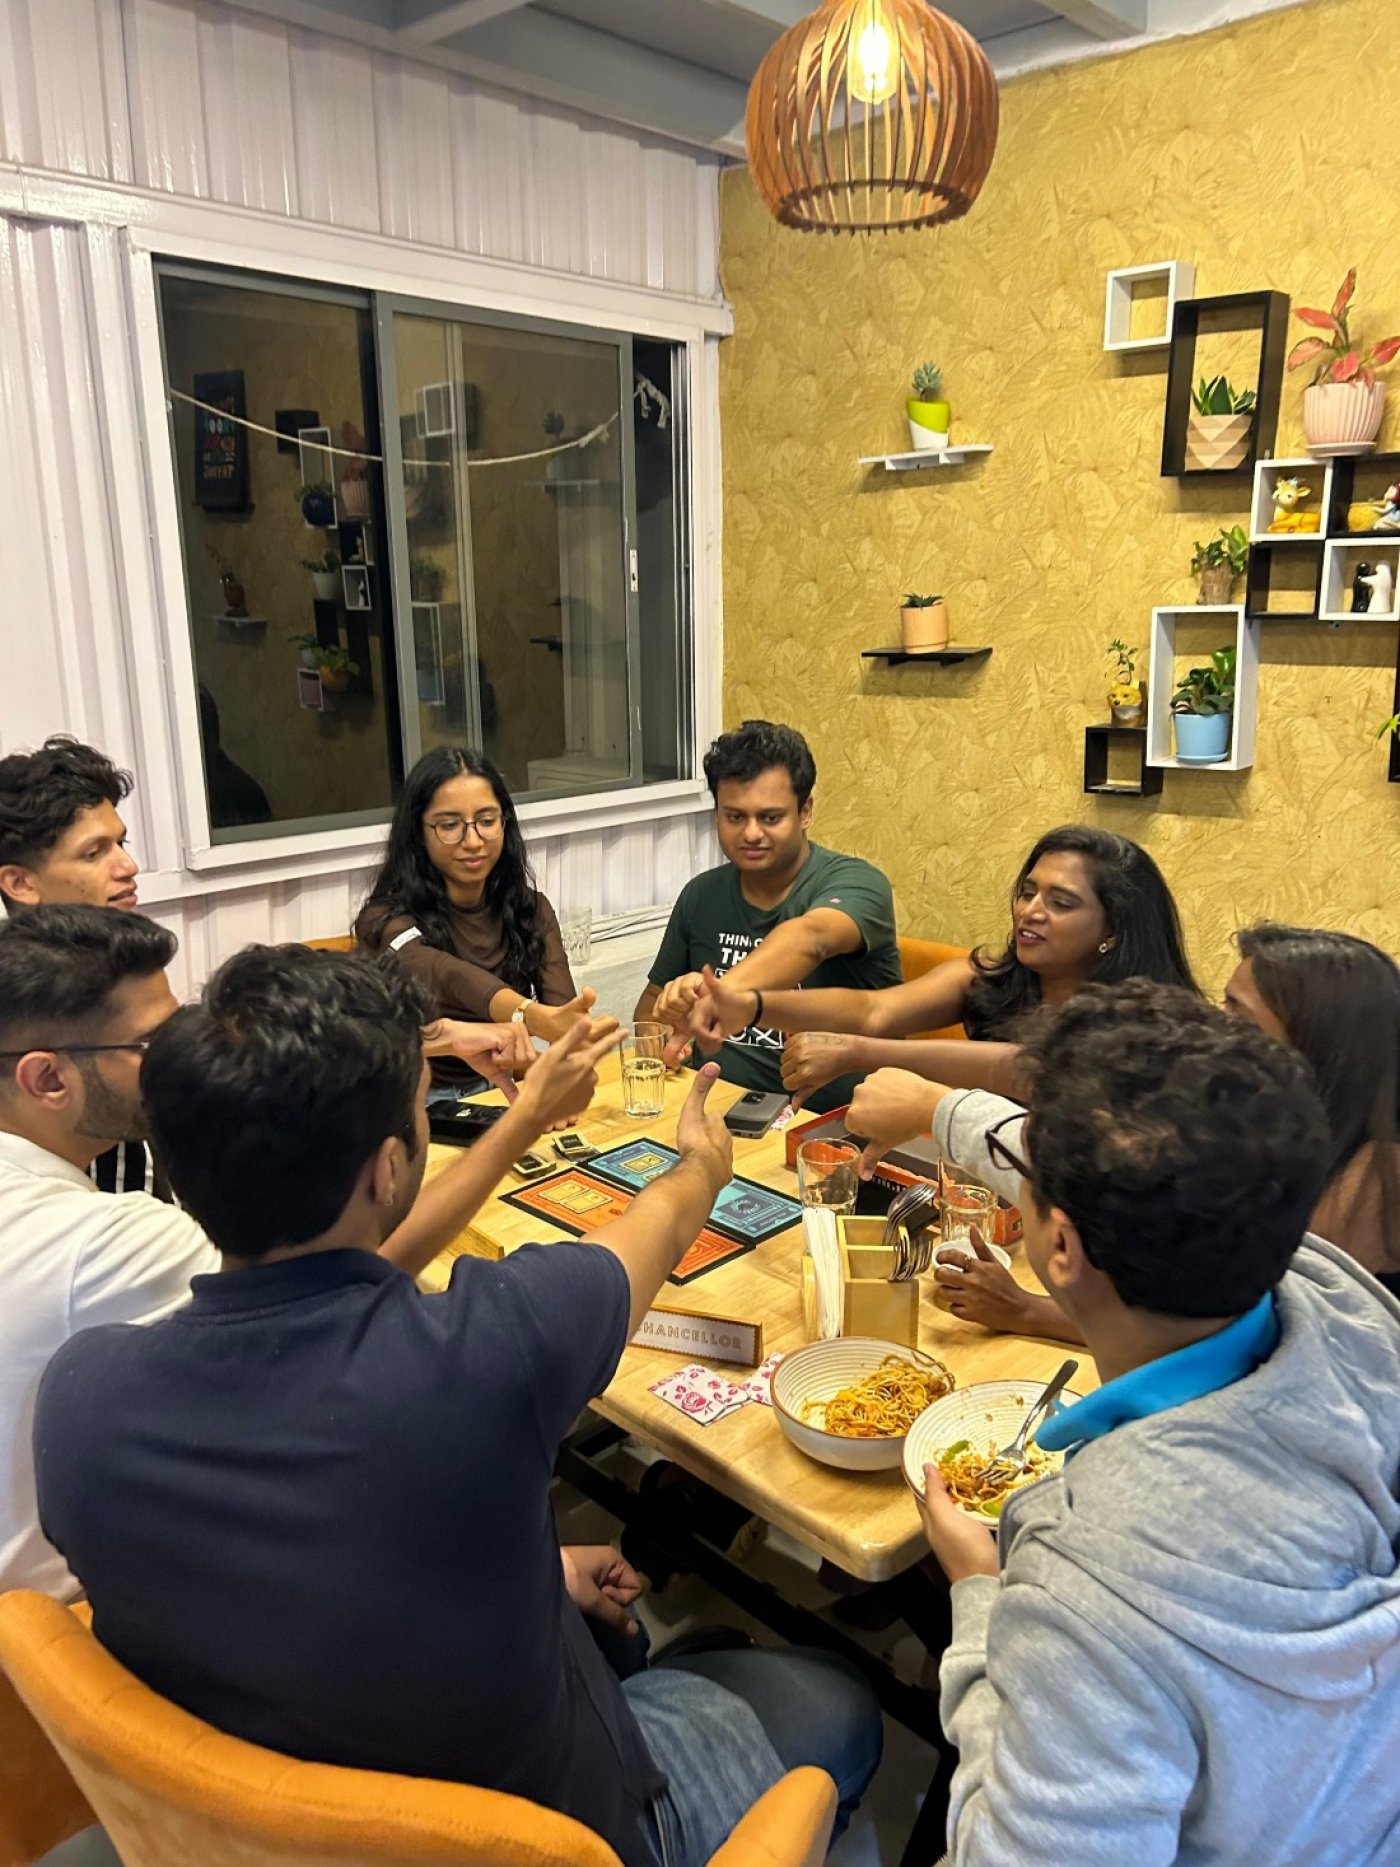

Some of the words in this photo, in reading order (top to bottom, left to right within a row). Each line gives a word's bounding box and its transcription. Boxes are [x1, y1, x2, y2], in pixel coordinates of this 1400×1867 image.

[718, 933, 752, 948] THIN
[721, 947, 748, 966] TH
[640, 1321, 742, 1350] HANCELLOR
